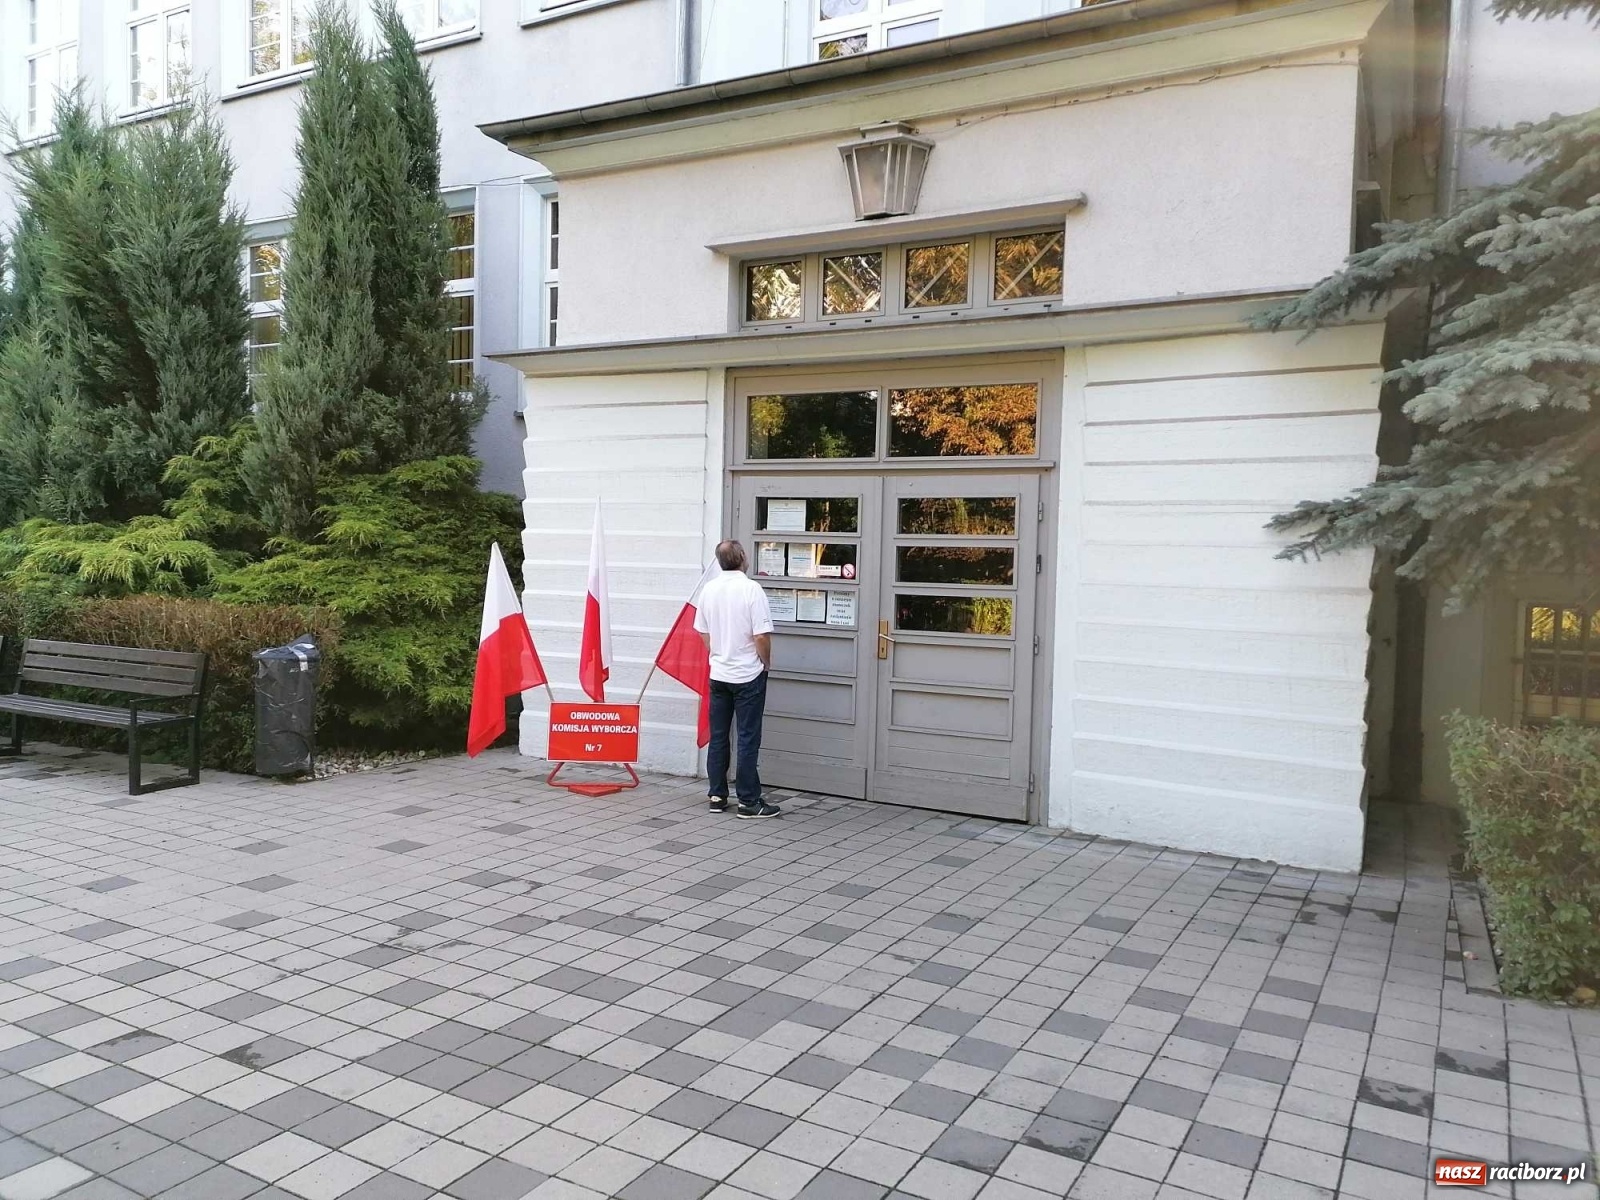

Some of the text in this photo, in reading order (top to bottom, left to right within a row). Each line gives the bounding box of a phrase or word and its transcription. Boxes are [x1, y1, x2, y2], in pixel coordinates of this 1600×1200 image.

[570, 712, 620, 720] OBWODOWA
[552, 724, 637, 733] KOMISJA WYBORCZA
